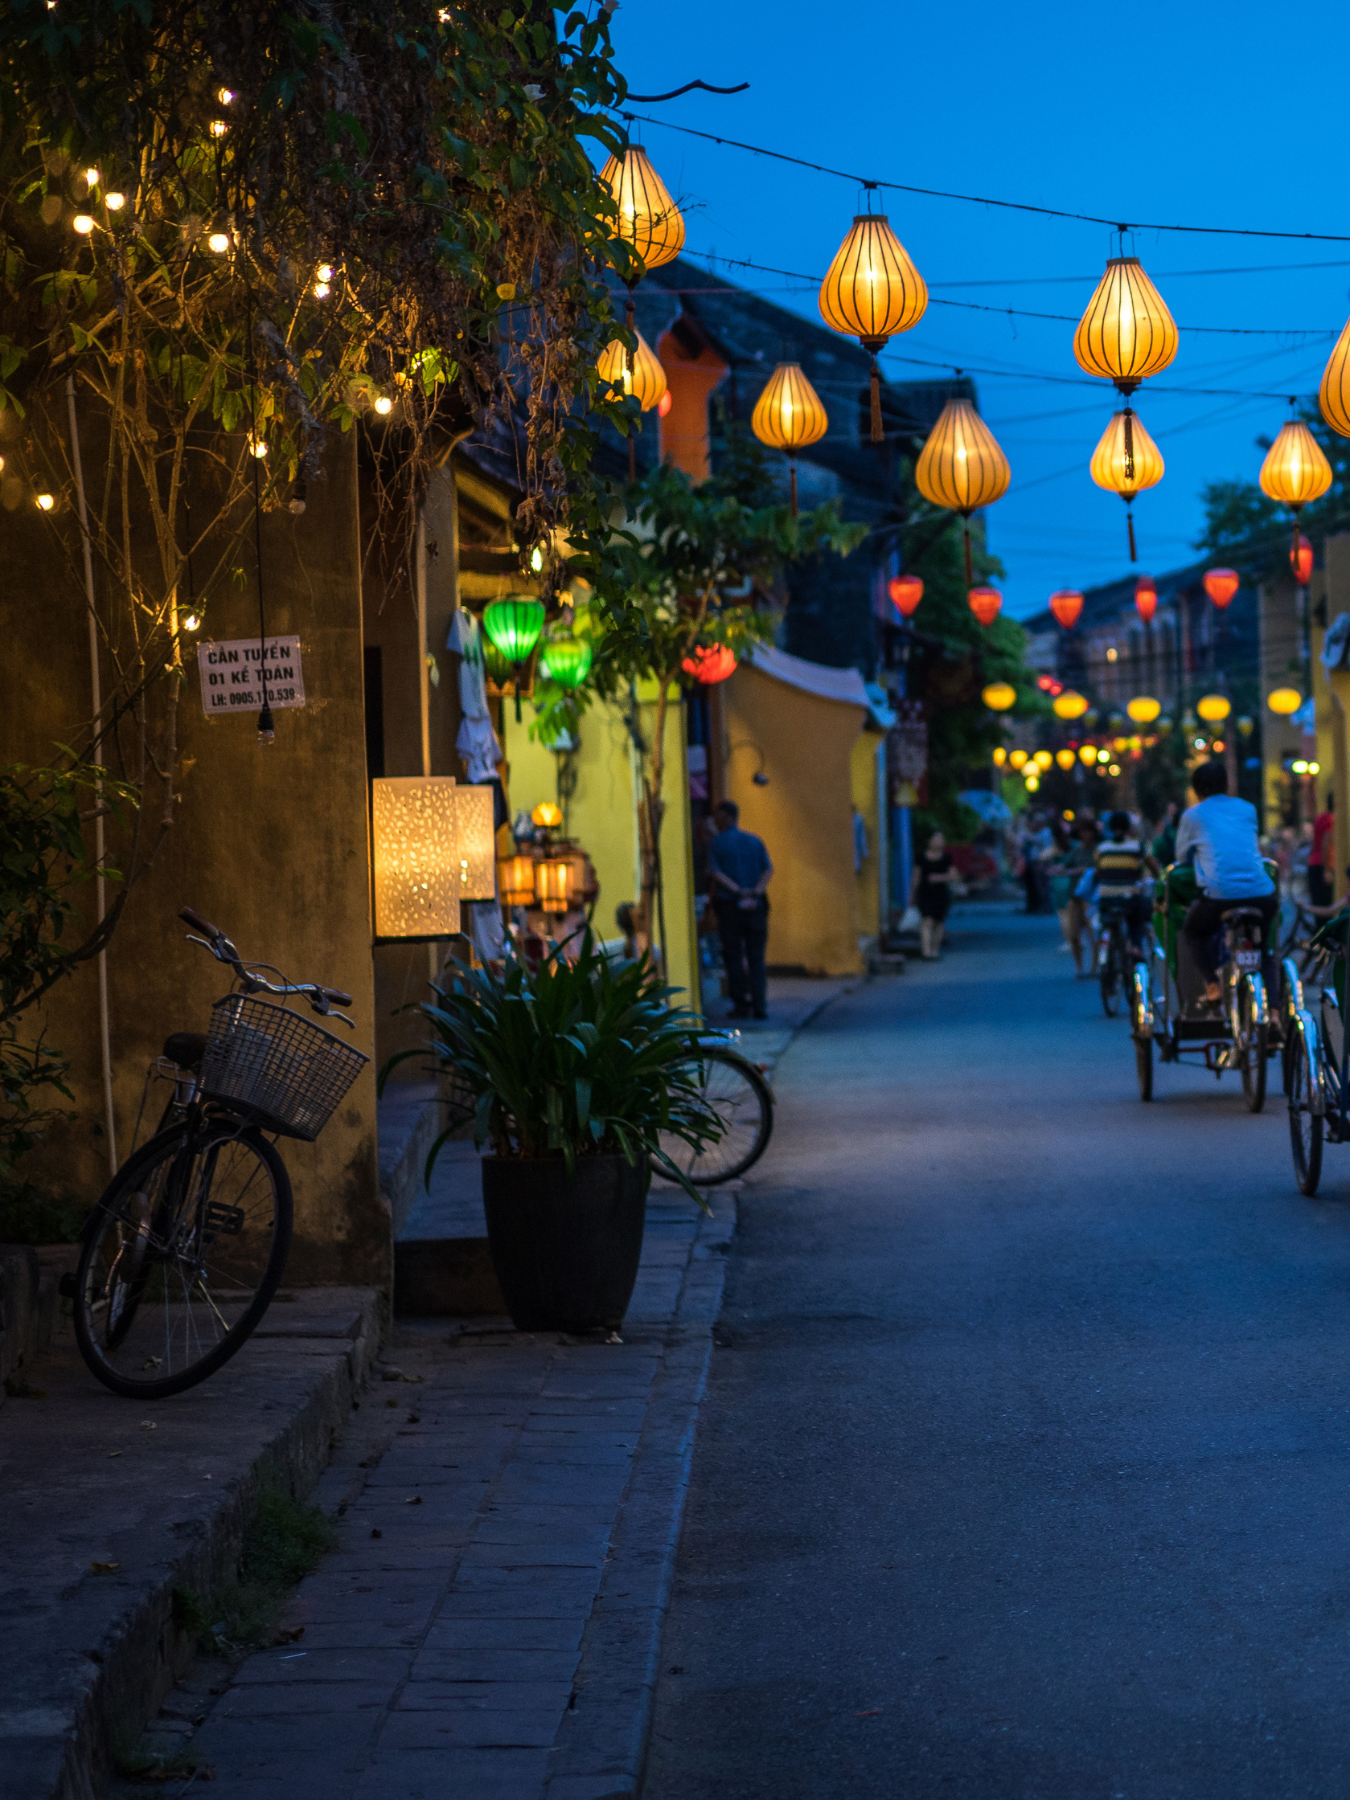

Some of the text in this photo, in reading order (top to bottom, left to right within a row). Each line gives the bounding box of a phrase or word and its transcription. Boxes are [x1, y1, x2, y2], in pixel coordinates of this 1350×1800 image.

[209, 673, 225, 685] 01
[211, 687, 295, 707] LH: 0905.10.539
